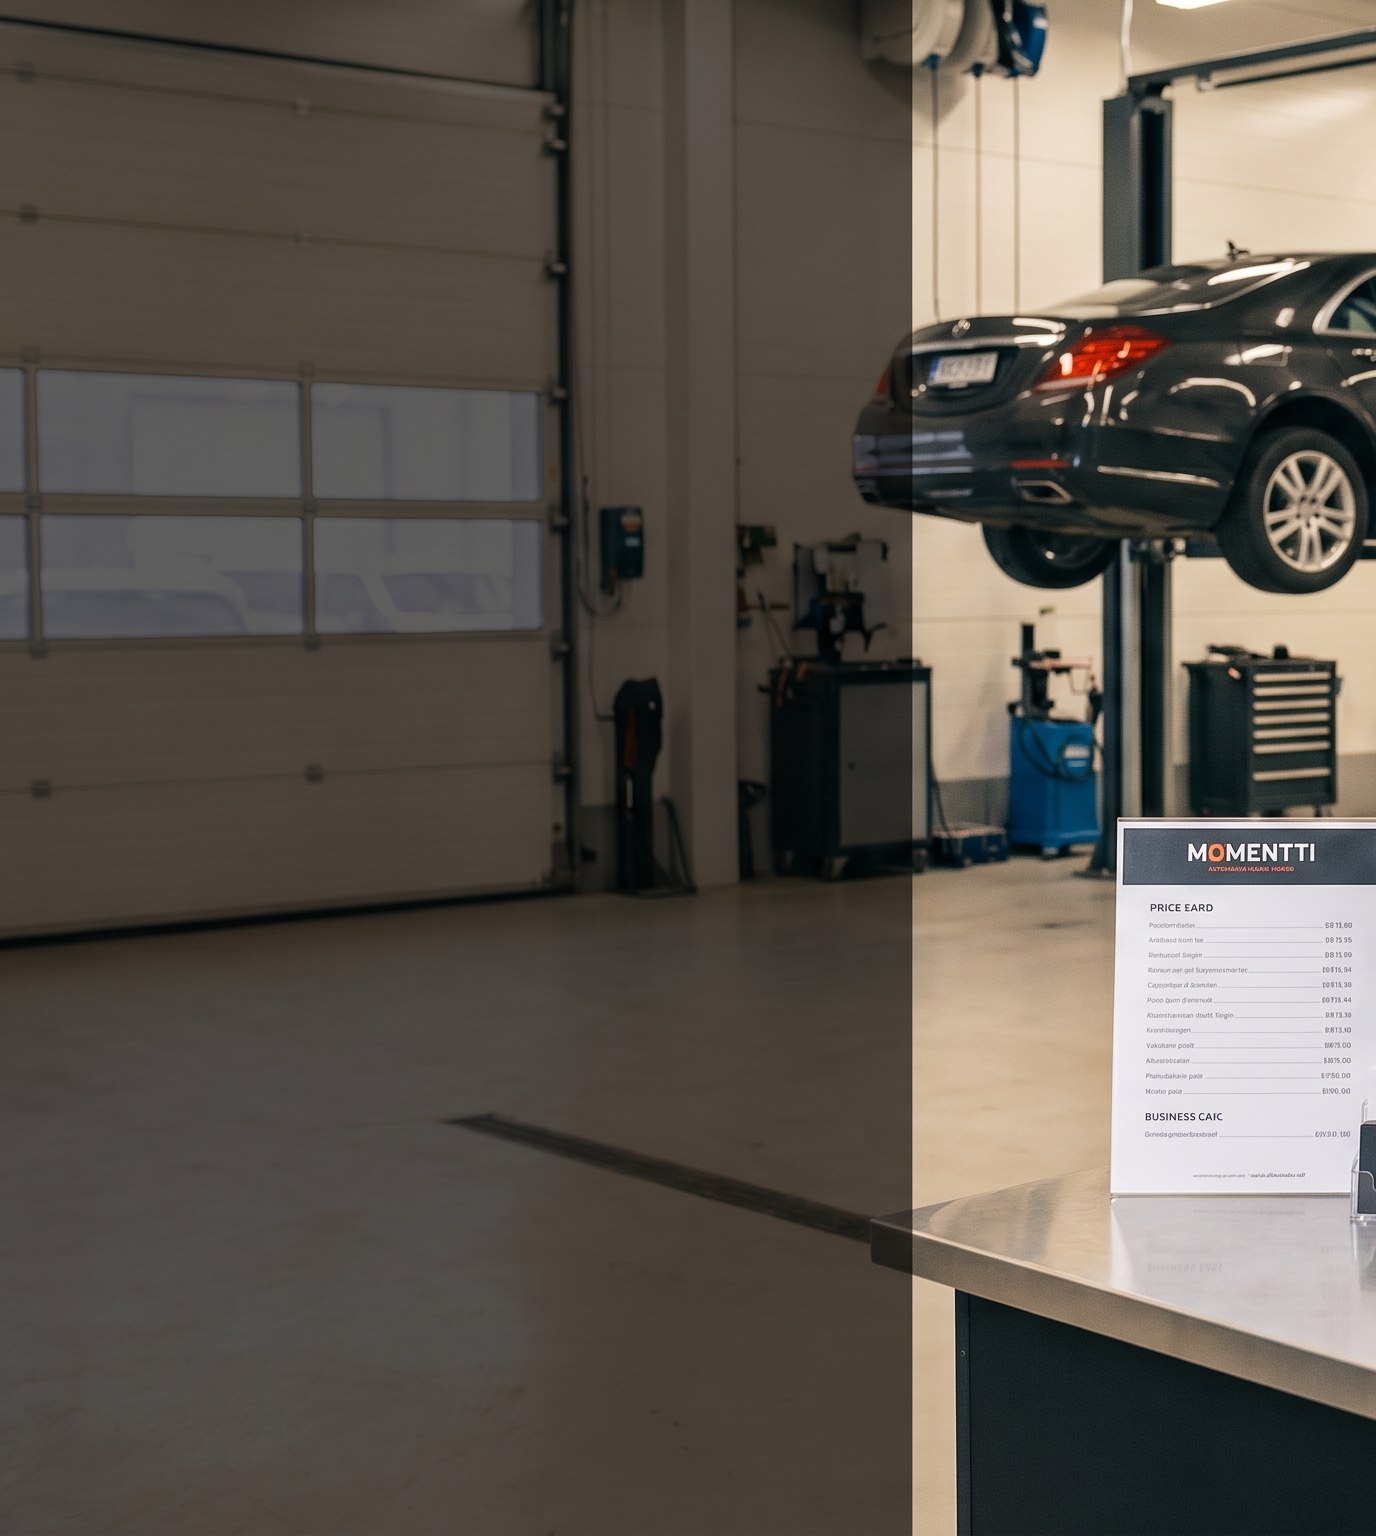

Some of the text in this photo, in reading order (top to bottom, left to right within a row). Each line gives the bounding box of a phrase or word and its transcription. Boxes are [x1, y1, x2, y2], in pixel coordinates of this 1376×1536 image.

[1187, 843, 1316, 862] MOMENTTI
[1150, 903, 1182, 912] PRICE
[1145, 1112, 1196, 1121] BUSINESS
